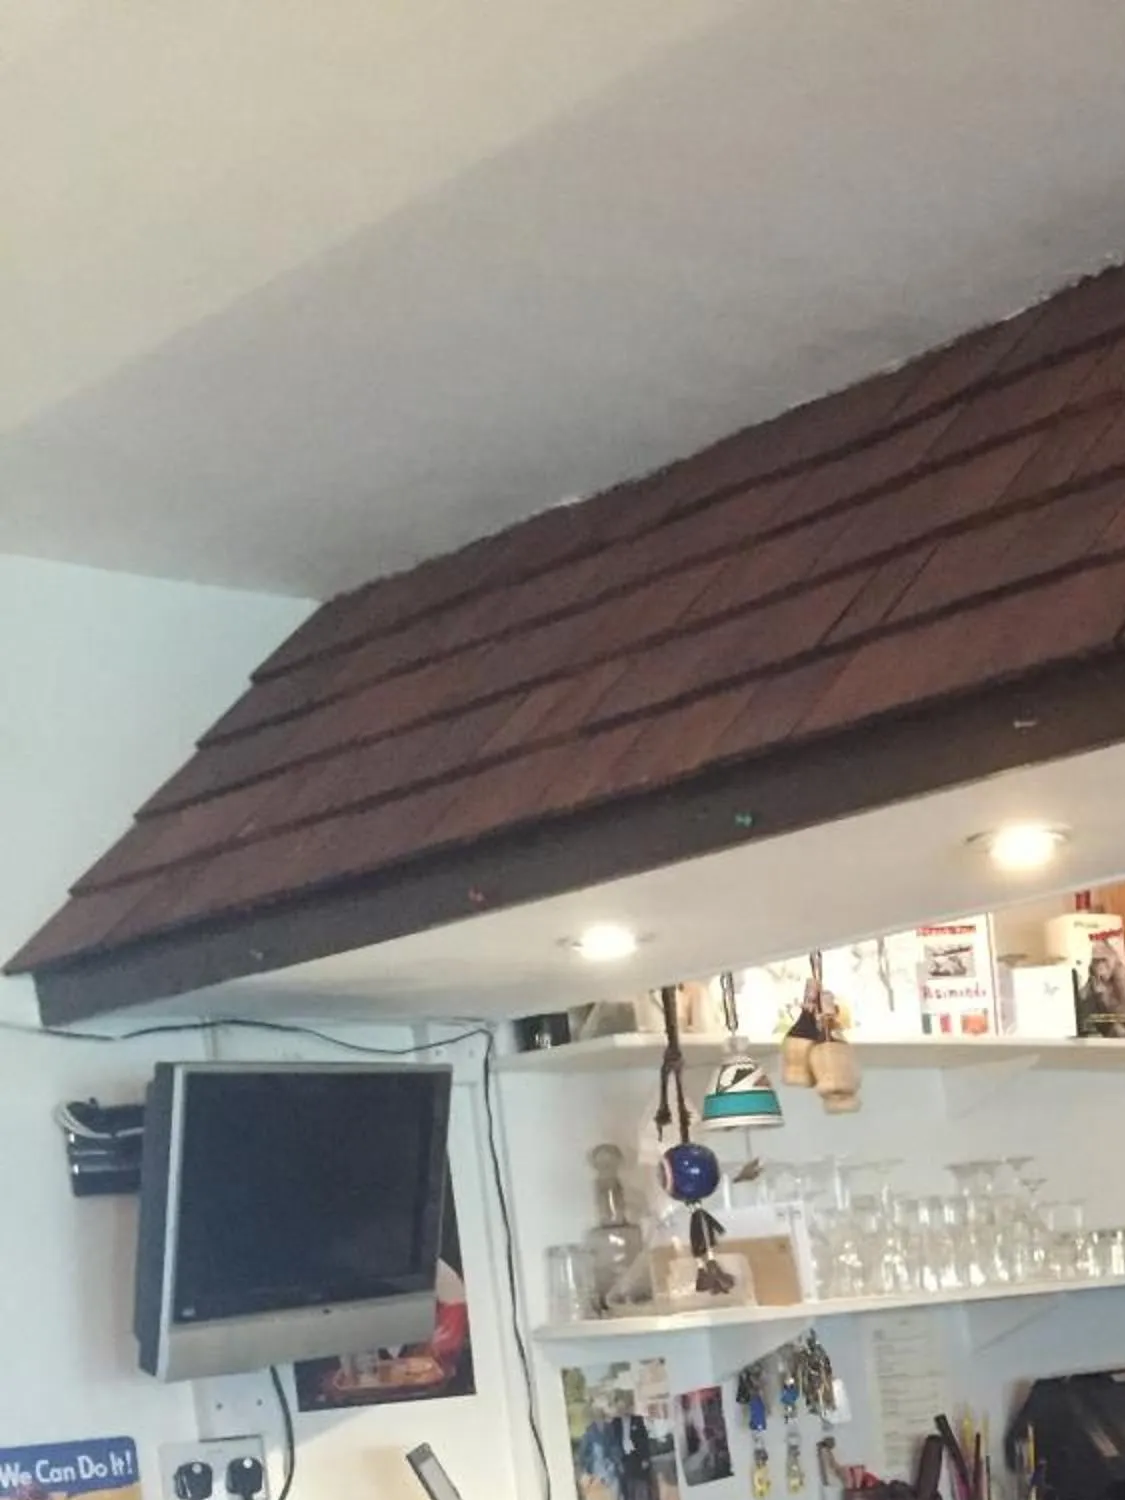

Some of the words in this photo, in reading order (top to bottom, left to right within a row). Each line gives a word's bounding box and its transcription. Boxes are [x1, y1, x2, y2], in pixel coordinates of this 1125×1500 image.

[0, 1462, 33, 1489] We
[36, 1459, 76, 1483] Can
[78, 1454, 108, 1479] Do
[109, 1449, 133, 1477] It!
